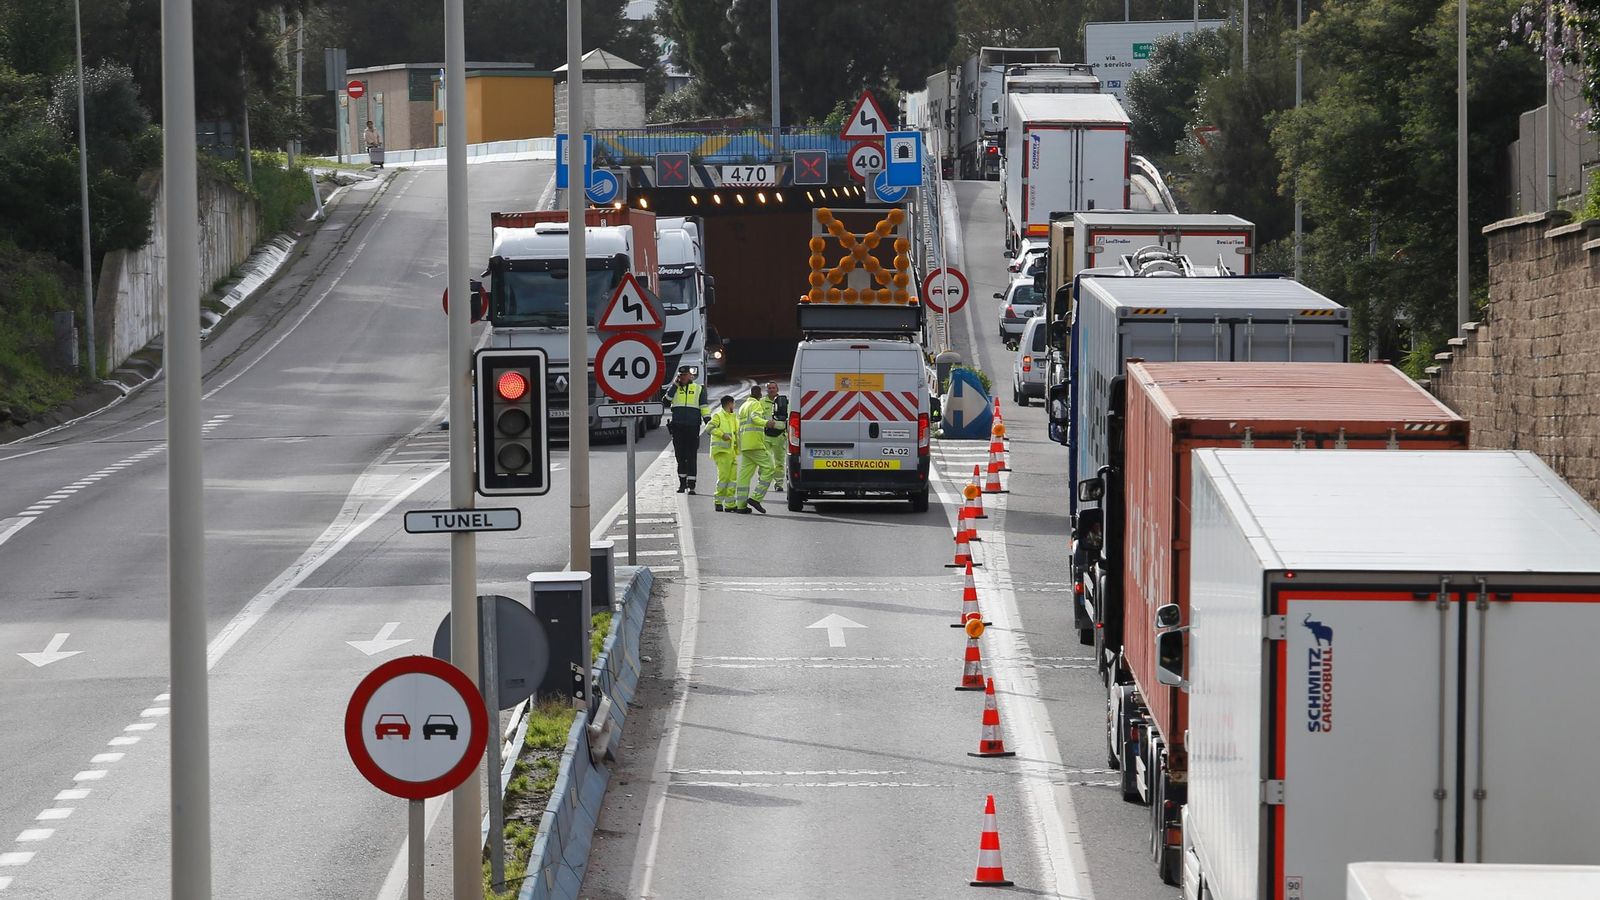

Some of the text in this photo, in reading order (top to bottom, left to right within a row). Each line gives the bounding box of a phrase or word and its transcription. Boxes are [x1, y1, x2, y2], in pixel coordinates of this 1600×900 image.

[855, 155, 880, 168] 40
[608, 356, 650, 379] 40
[613, 406, 649, 415] TUNEL
[882, 447, 909, 455] CA-02
[825, 459, 890, 468] CONSERVACIÓN
[432, 513, 493, 528] TUNEL
[1308, 648, 1321, 732] SCHMITZ
[1322, 647, 1333, 732] CARGOBULL
[1288, 881, 1300, 890] 90
